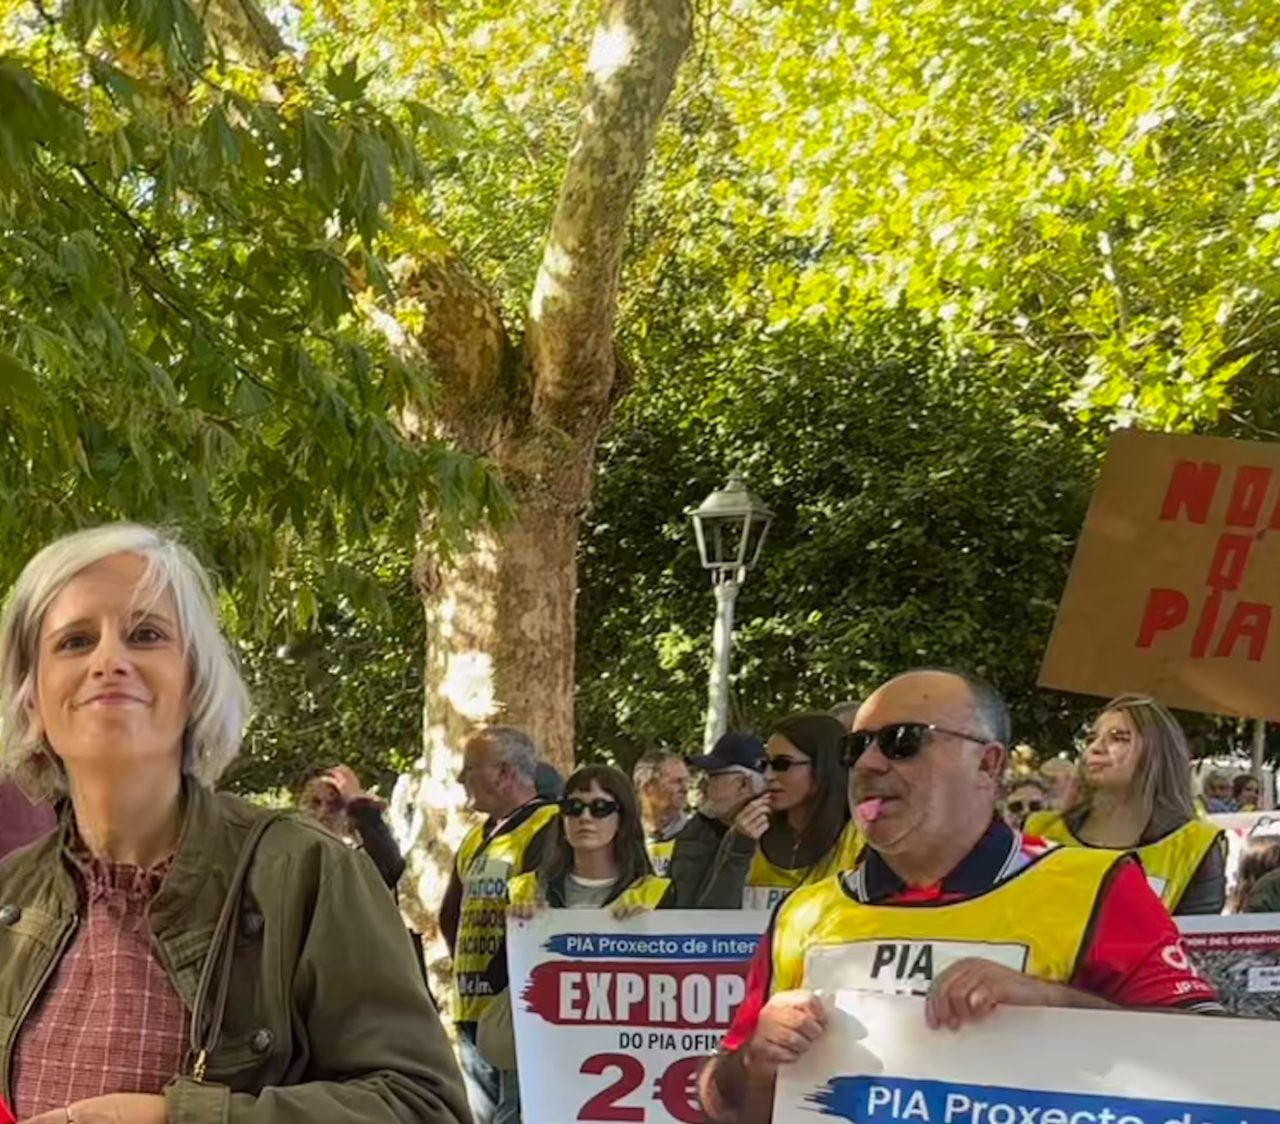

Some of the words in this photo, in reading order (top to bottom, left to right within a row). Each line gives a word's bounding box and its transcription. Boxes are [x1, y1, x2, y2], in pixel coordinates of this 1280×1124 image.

[1158, 460, 1280, 532] NO
[566, 937, 595, 952] PIA
[598, 938, 679, 955] Proxecto
[681, 938, 709, 954] de
[869, 943, 933, 980] PIA
[558, 971, 747, 1026] EXPROP
[619, 1032, 643, 1050] DO
[648, 1033, 677, 1051] PIA
[866, 1085, 931, 1123] PIA
